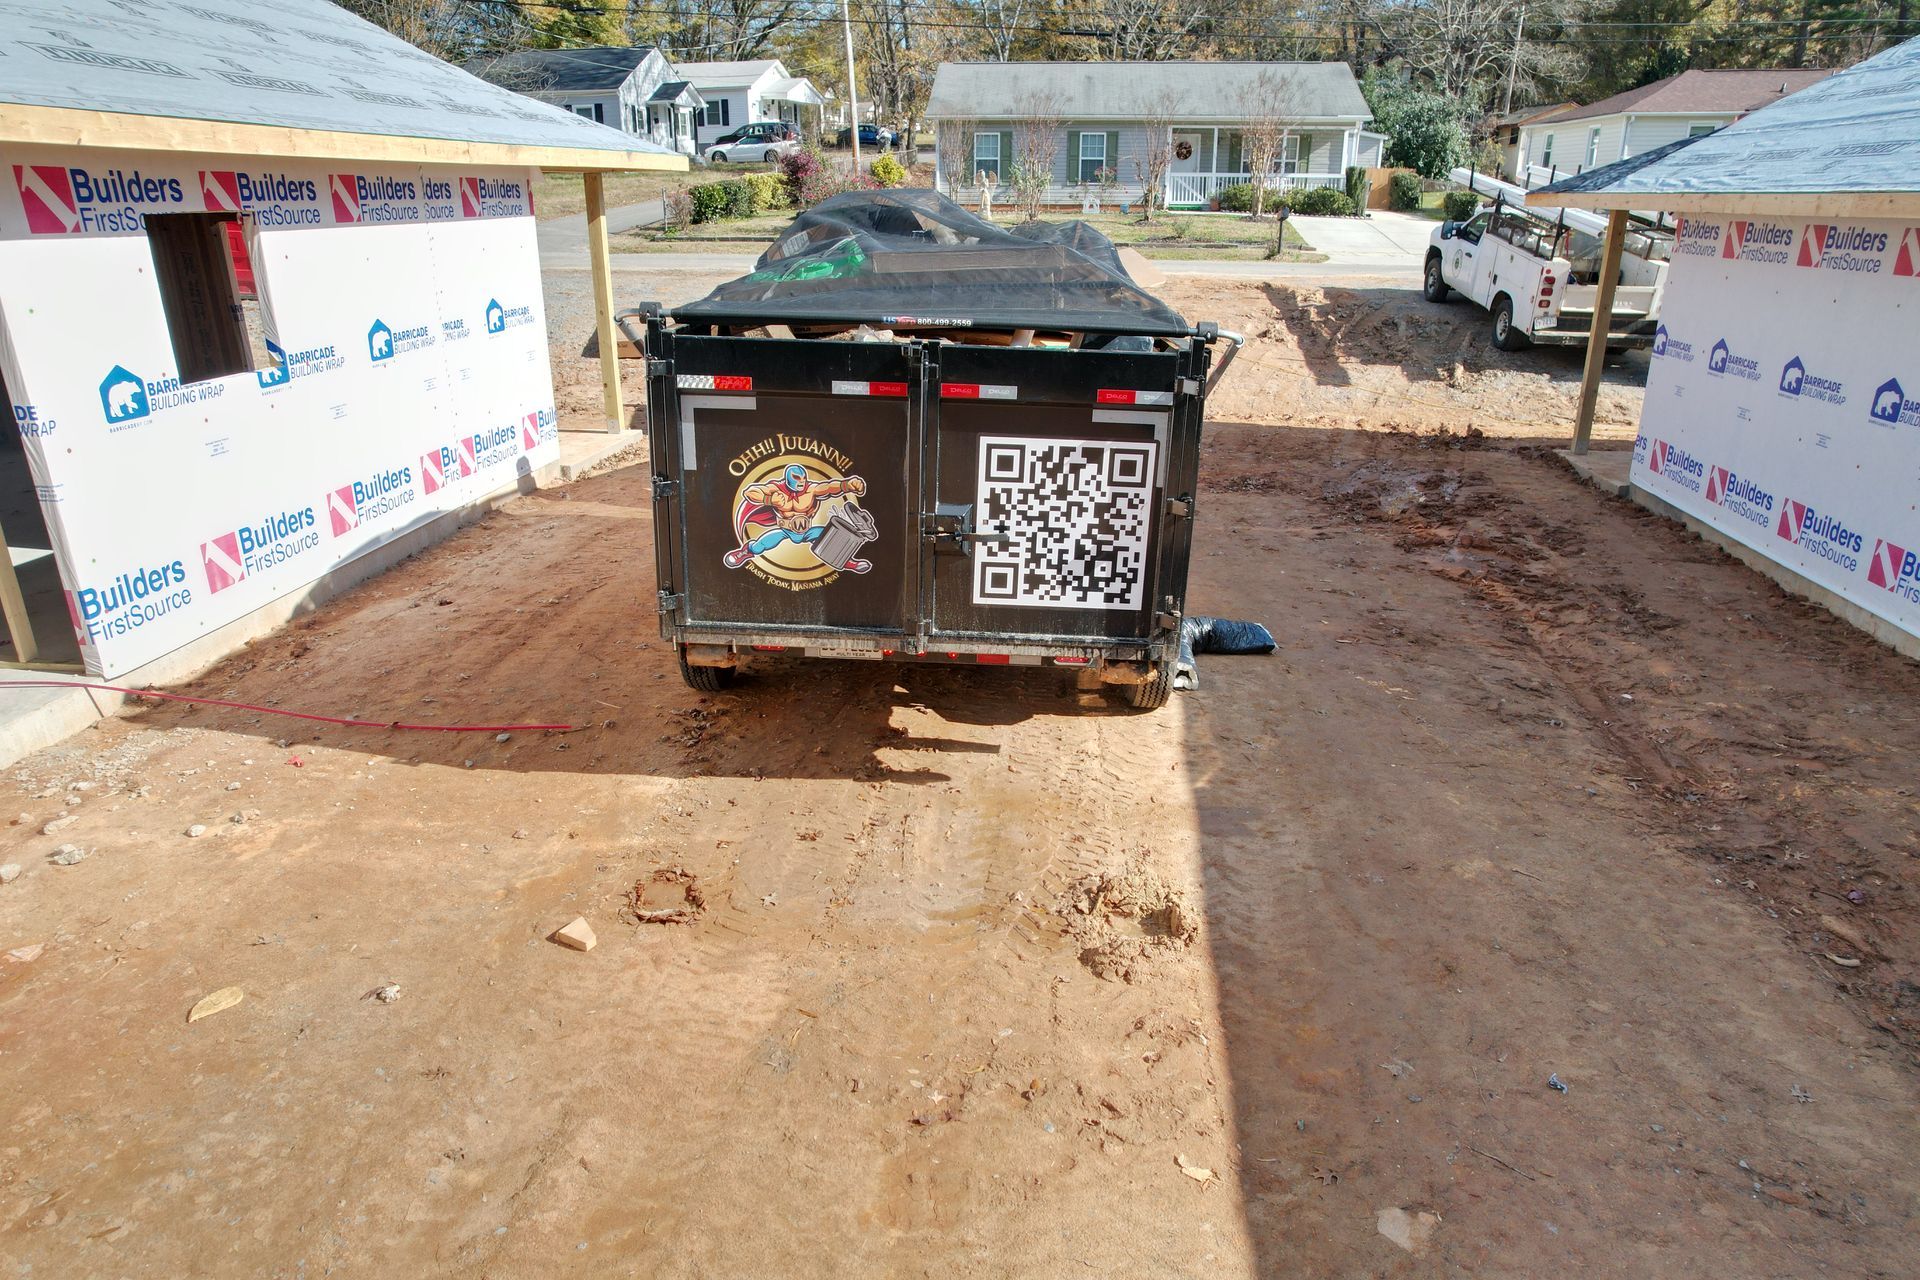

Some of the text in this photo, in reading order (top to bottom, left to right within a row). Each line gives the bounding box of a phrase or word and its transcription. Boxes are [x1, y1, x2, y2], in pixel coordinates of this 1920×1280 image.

[69, 168, 183, 203] Builders
[236, 172, 317, 202] Builders
[357, 175, 416, 200] Builders
[479, 178, 521, 199] Builders
[241, 204, 321, 226] FirstSource
[360, 203, 419, 223] FirstSource
[481, 201, 523, 217] FirstSource
[1681, 218, 1720, 240] Builders
[1744, 222, 1793, 246] Builders
[1825, 226, 1888, 252] Builders
[1679, 240, 1717, 257] FirstSource
[1740, 246, 1789, 264] FirstSource
[1819, 251, 1881, 273] FirstSource
[393, 326, 429, 343] BARRICADE
[394, 336, 436, 355] BUILDING WRAP
[1667, 338, 1692, 354] BARRICADE
[288, 345, 336, 366] BARRICADE
[290, 356, 345, 379] BUILDING WRAP
[1727, 354, 1758, 371] BARRICADE
[1725, 364, 1747, 379] BUILDING
[1746, 370, 1762, 381] WRAP
[1803, 375, 1842, 393] BARRICADE
[150, 383, 225, 412] BUILDING WRAP
[1801, 384, 1828, 401] BUILDING
[1827, 393, 1847, 405] WRAP
[19, 420, 57, 438] WRAP
[473, 425, 516, 454] Builders
[477, 444, 518, 471] FirstSource
[728, 438, 775, 476] OHH!!
[1666, 445, 1704, 477] Builders
[353, 467, 412, 505] Builders
[1664, 464, 1700, 493] FirstSource
[1727, 472, 1773, 511] Builders
[357, 488, 415, 524] FirstSource
[1723, 494, 1769, 529] FirstSource
[238, 507, 316, 555] Builders
[1802, 507, 1863, 553] Builders
[244, 531, 320, 577] FirstSource
[1798, 530, 1857, 572] FirstSource
[745, 560, 766, 579] TRASH
[78, 560, 186, 620] Builders
[86, 588, 192, 645] FirstSource
